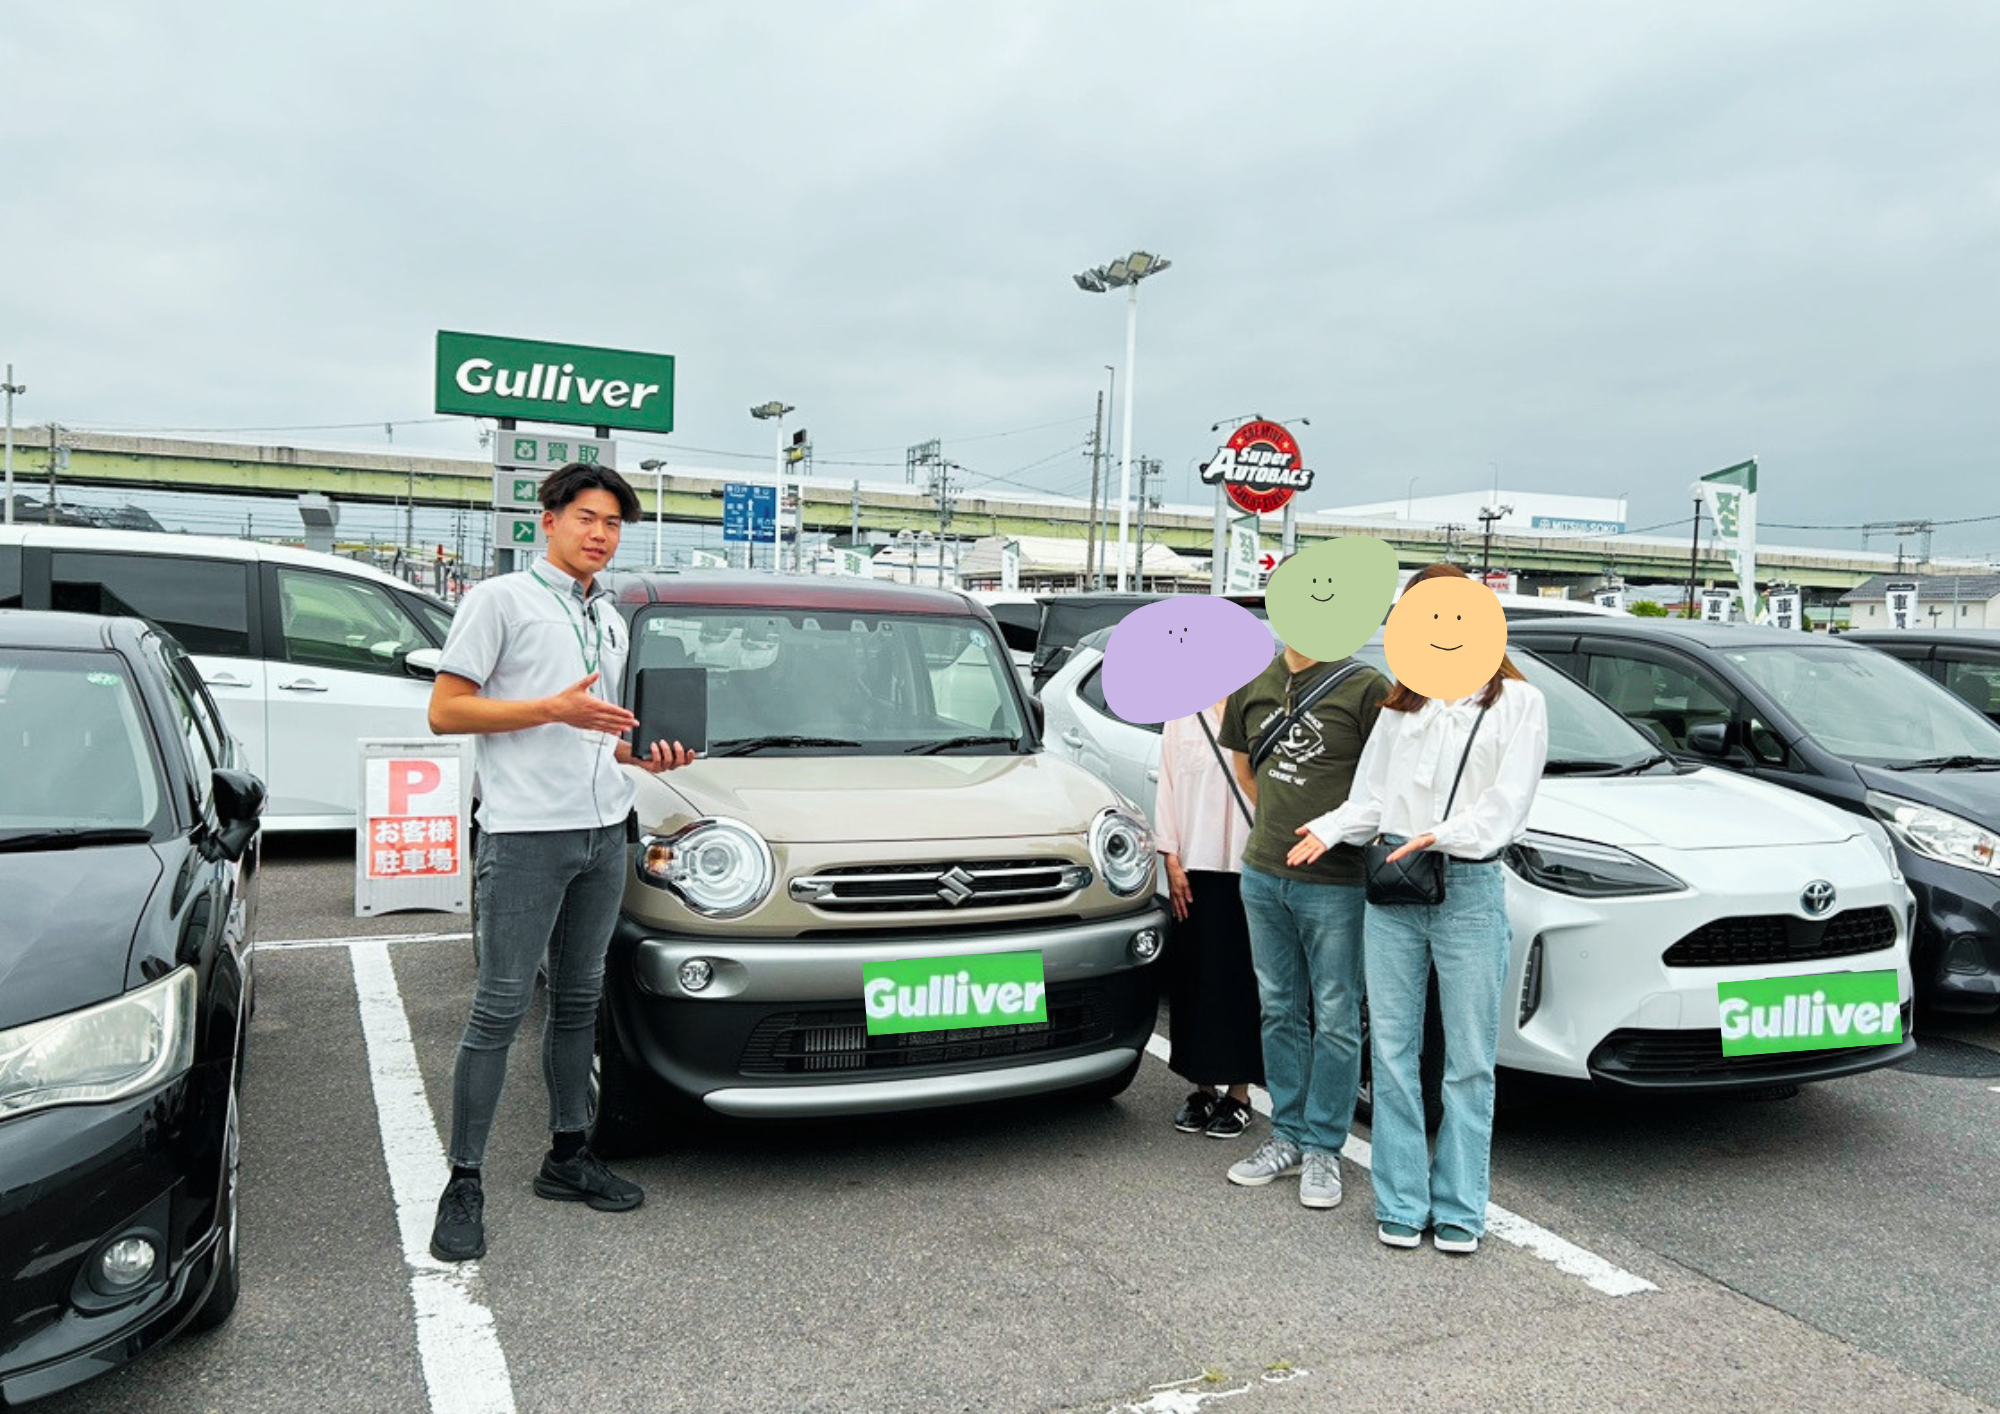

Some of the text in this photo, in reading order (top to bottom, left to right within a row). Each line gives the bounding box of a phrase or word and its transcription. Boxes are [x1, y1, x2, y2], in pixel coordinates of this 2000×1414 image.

[455, 357, 660, 410] Gulliver
[547, 441, 600, 465] 買取
[1237, 447, 1293, 466] Super
[1202, 447, 1311, 487] AUTOBACS
[388, 759, 442, 816] P
[374, 819, 453, 843] お客様
[374, 848, 453, 874] 駐車場
